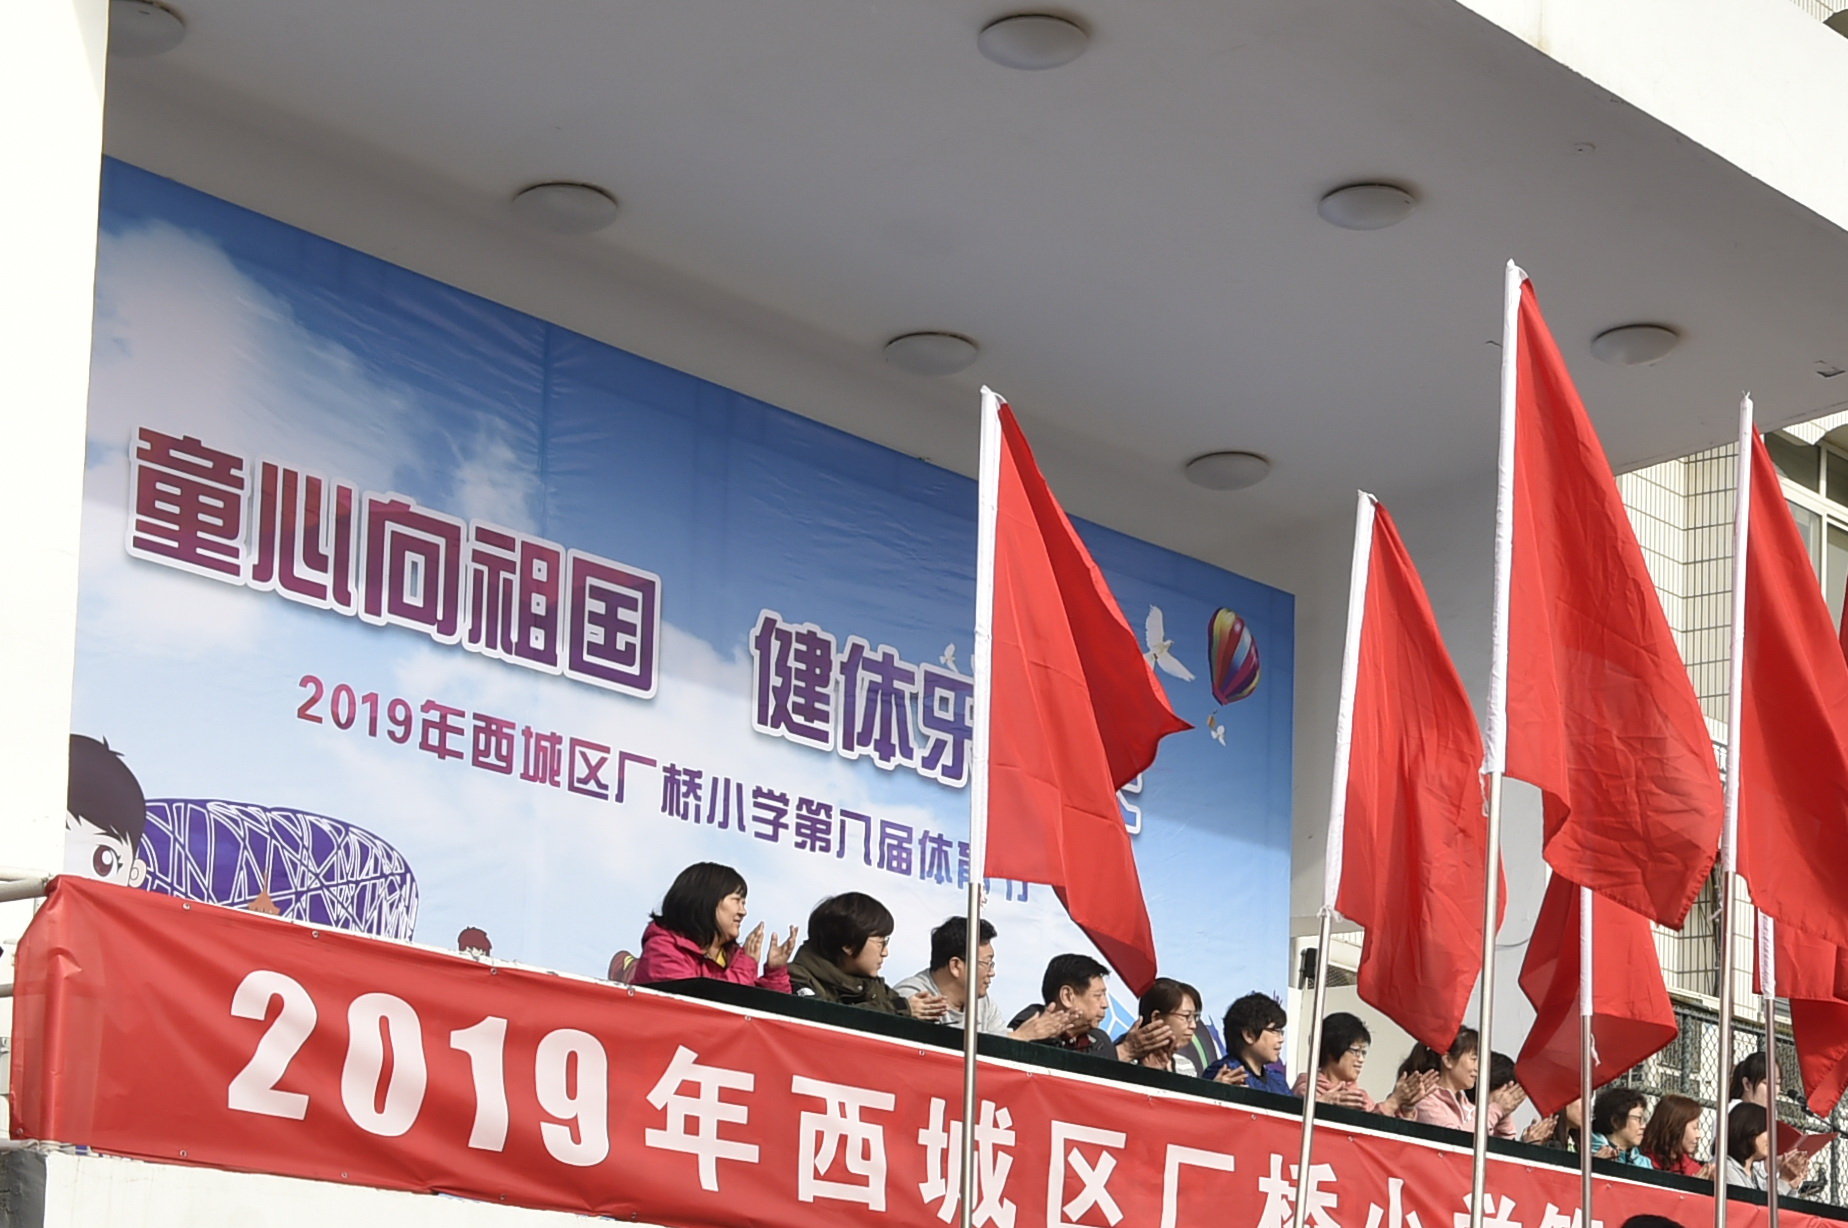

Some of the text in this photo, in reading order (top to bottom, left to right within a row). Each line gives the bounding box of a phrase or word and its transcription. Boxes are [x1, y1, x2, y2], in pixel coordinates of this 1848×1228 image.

[130, 426, 661, 694] 童心向祖国
[297, 674, 1028, 903] 2019年西城区厂桥小学第八届体
